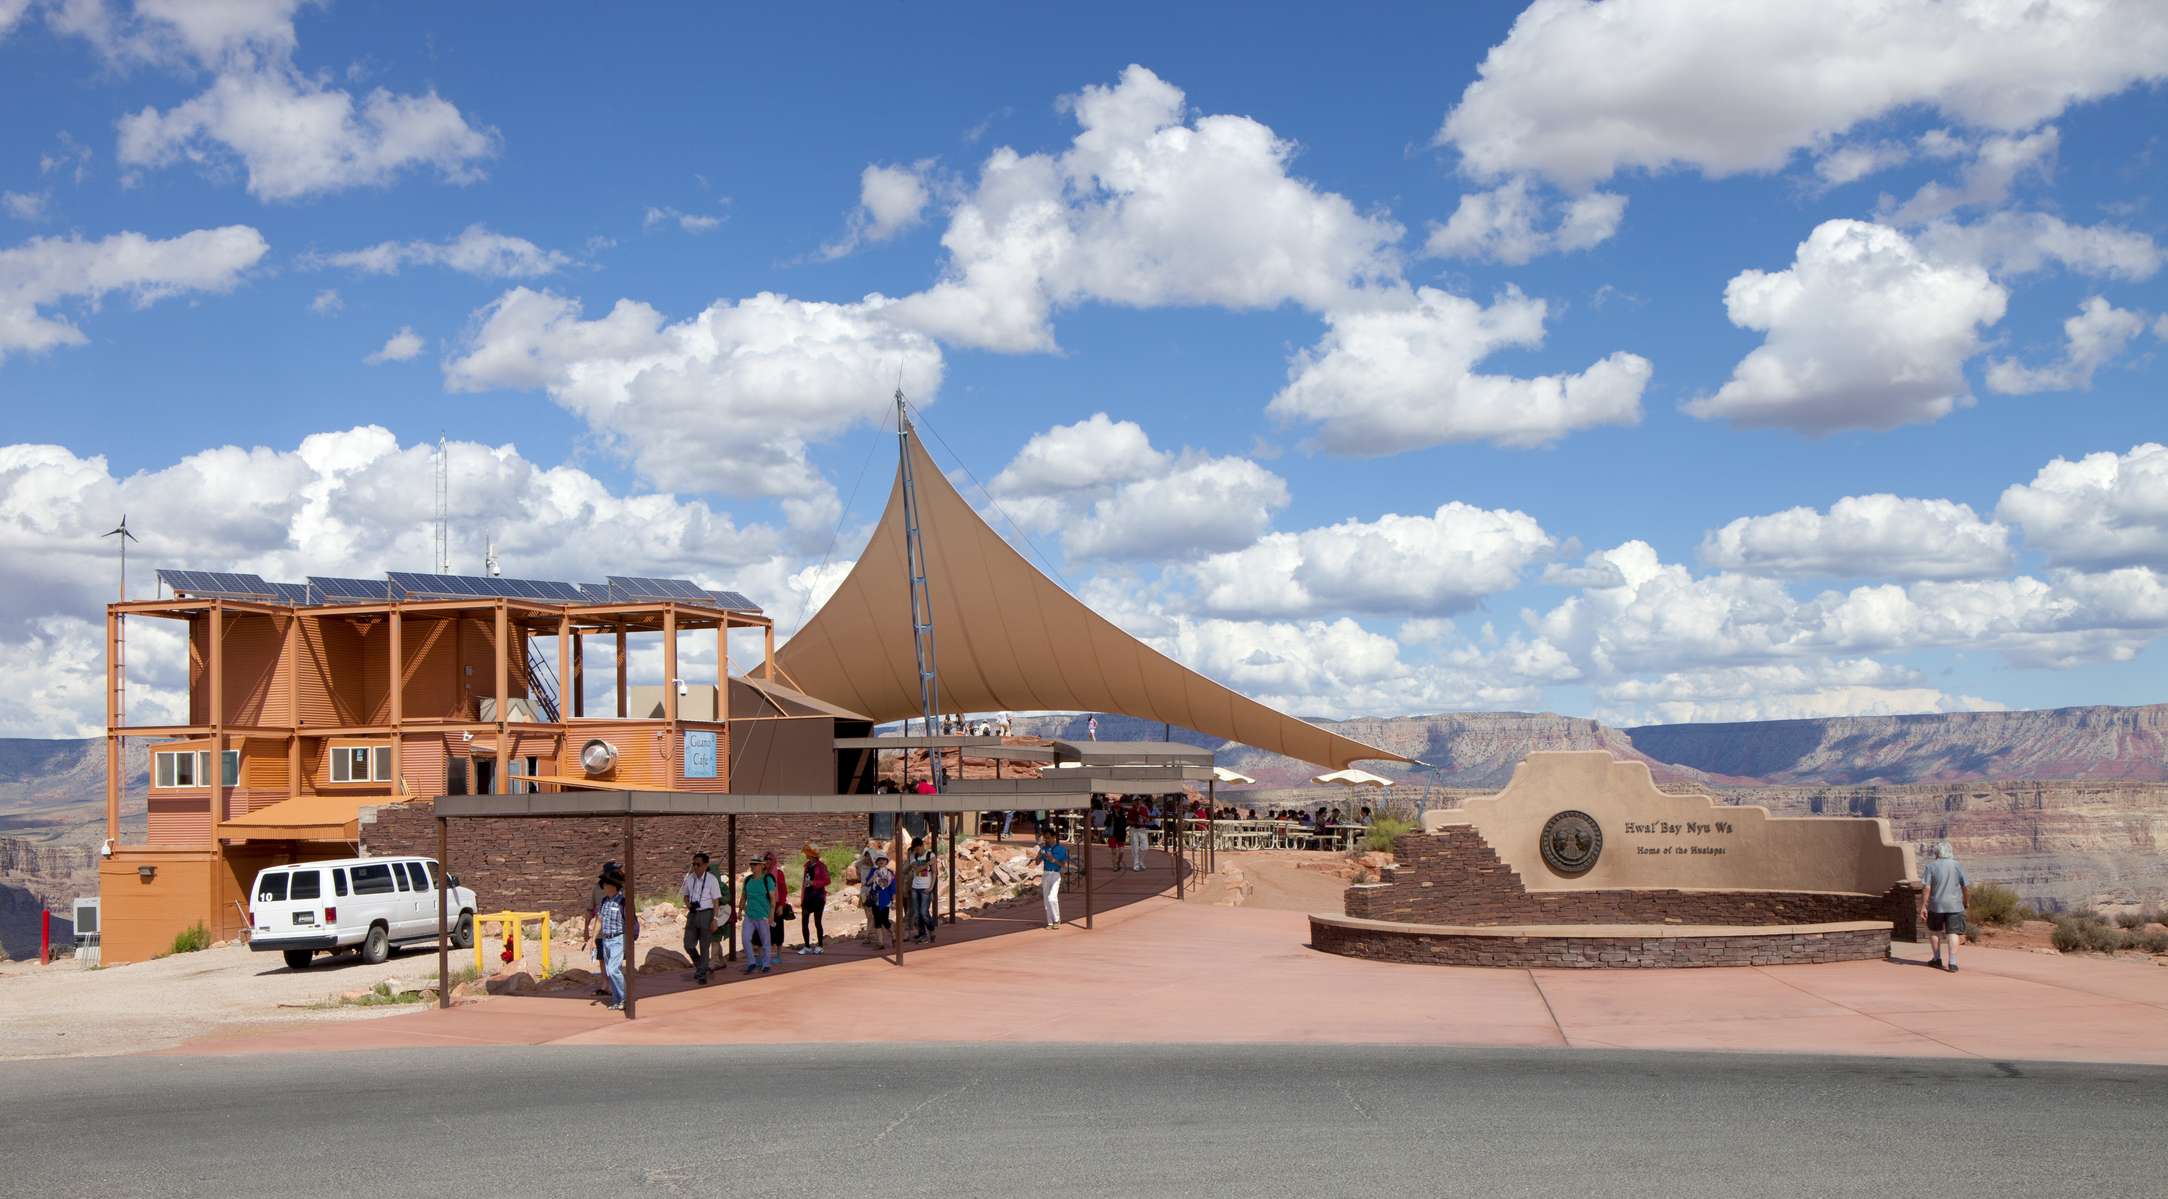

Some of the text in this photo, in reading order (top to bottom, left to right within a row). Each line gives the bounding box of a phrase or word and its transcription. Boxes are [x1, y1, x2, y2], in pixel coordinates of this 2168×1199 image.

[1660, 821, 1682, 836] Bay
[1686, 821, 1711, 836] Nyu
[1715, 821, 1733, 834] Wa
[1636, 846, 1660, 855] Home
[1663, 846, 1672, 855] of
[1675, 846, 1688, 855] the
[260, 892, 273, 902] 10
